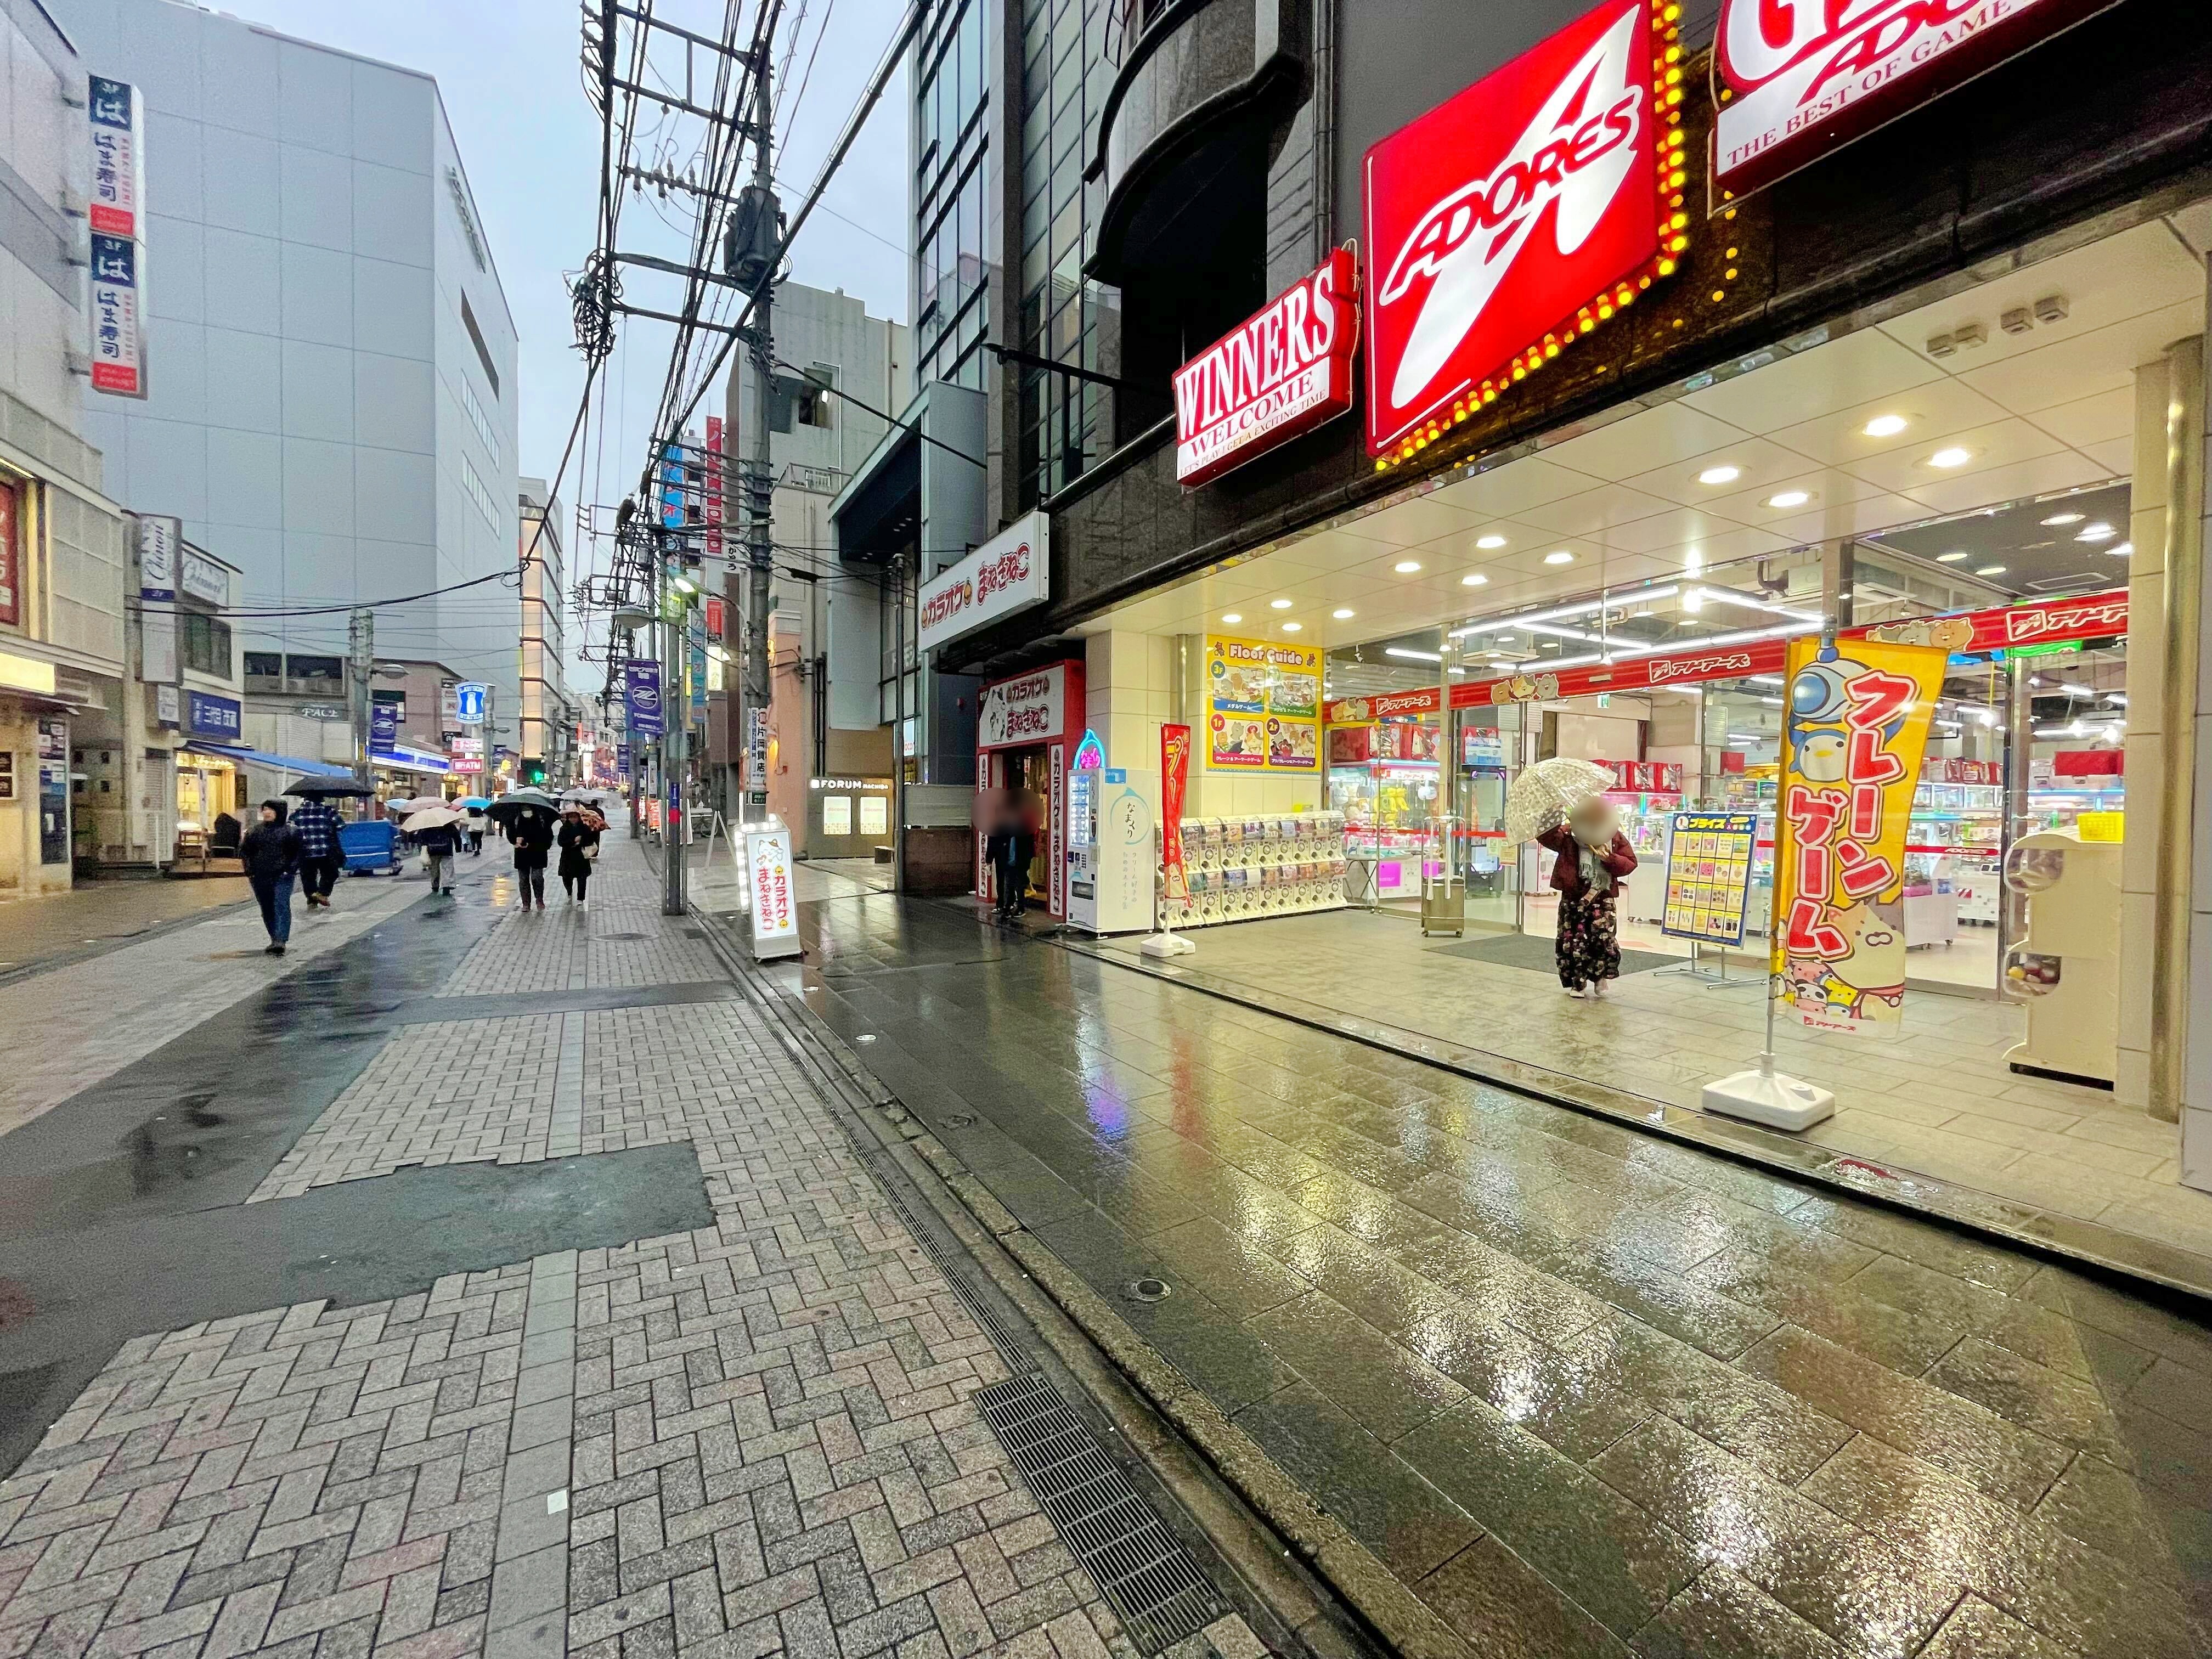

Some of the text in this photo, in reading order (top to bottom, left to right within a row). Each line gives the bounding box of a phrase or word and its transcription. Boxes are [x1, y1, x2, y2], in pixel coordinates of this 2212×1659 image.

[1726, 128, 1777, 166] THE
[1785, 86, 1852, 137] BEST
[1861, 57, 1901, 92] OF
[1381, 88, 1642, 303] ADORES
[1175, 261, 1335, 441] WINNERS
[1190, 370, 1313, 457] WELCOME
[1201, 448, 1220, 466] PLAY
[1227, 436, 1243, 451] GET
[1246, 432, 1251, 441] A
[1255, 405, 1297, 436] EXCITING
[1300, 389, 1325, 410] TIME
[928, 542, 1030, 627] カラオケ まねきねこ
[2047, 603, 2129, 630] アドア
[1214, 665, 1223, 674] 3F
[1229, 644, 1304, 665] Floor Guide
[1671, 653, 1751, 675] アドアーズ
[1012, 676, 1042, 701] カラオケ
[1388, 696, 1431, 710] アドアーズ
[1007, 704, 1049, 740] まねきねこ
[1213, 718, 1222, 728] 1F
[1269, 721, 1278, 731] 2F
[821, 780, 862, 789] FORUM
[1843, 667, 1919, 898] クレーン
[1689, 817, 1727, 830] プライズ
[1786, 783, 1852, 963] ゲーム
[758, 867, 773, 930] まねきねこ
[774, 876, 789, 919] カラオケ
